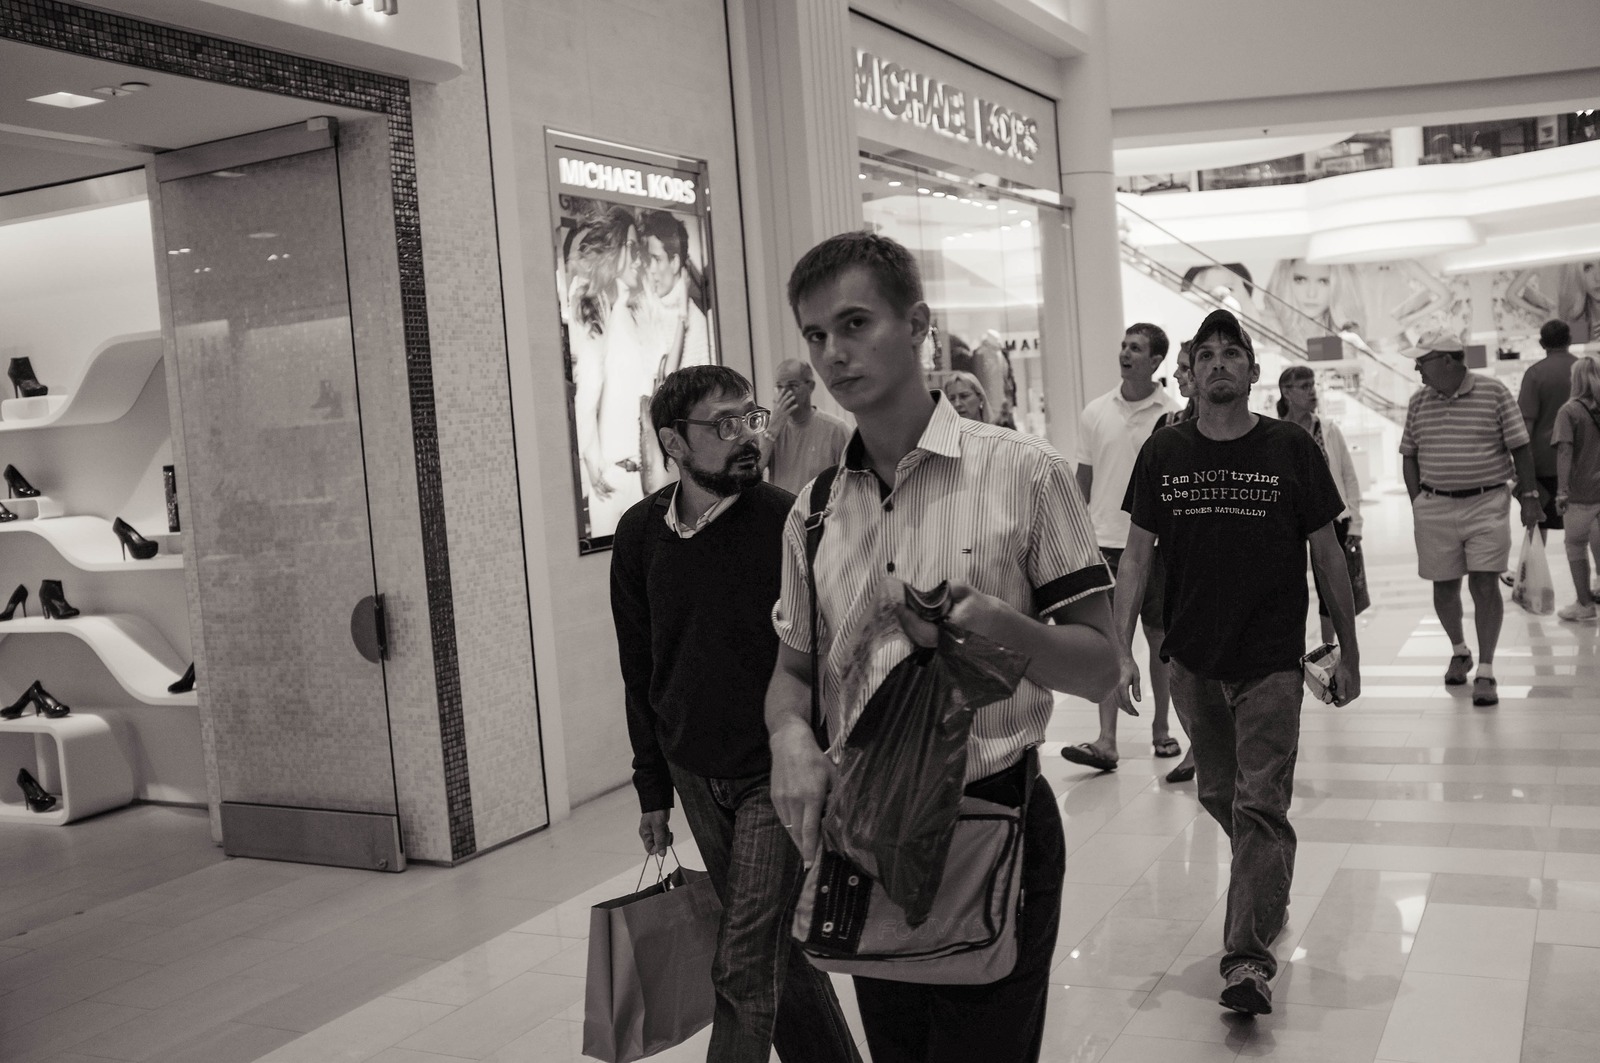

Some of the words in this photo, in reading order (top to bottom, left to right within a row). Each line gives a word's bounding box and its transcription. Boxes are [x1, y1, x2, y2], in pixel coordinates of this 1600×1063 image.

[852, 48, 971, 143] MICHAEL
[972, 97, 1040, 165] KORS
[559, 157, 648, 197] MICHAEL
[646, 173, 697, 205] KORS
[1161, 474, 1170, 487] I
[1172, 474, 1190, 485] am
[1193, 469, 1229, 484] NOT
[1230, 470, 1280, 486] trying
[1160, 492, 1173, 502] to
[1173, 487, 1189, 499] be
[1189, 487, 1281, 503] DIFFICULT
[1184, 506, 1213, 516] COMES
